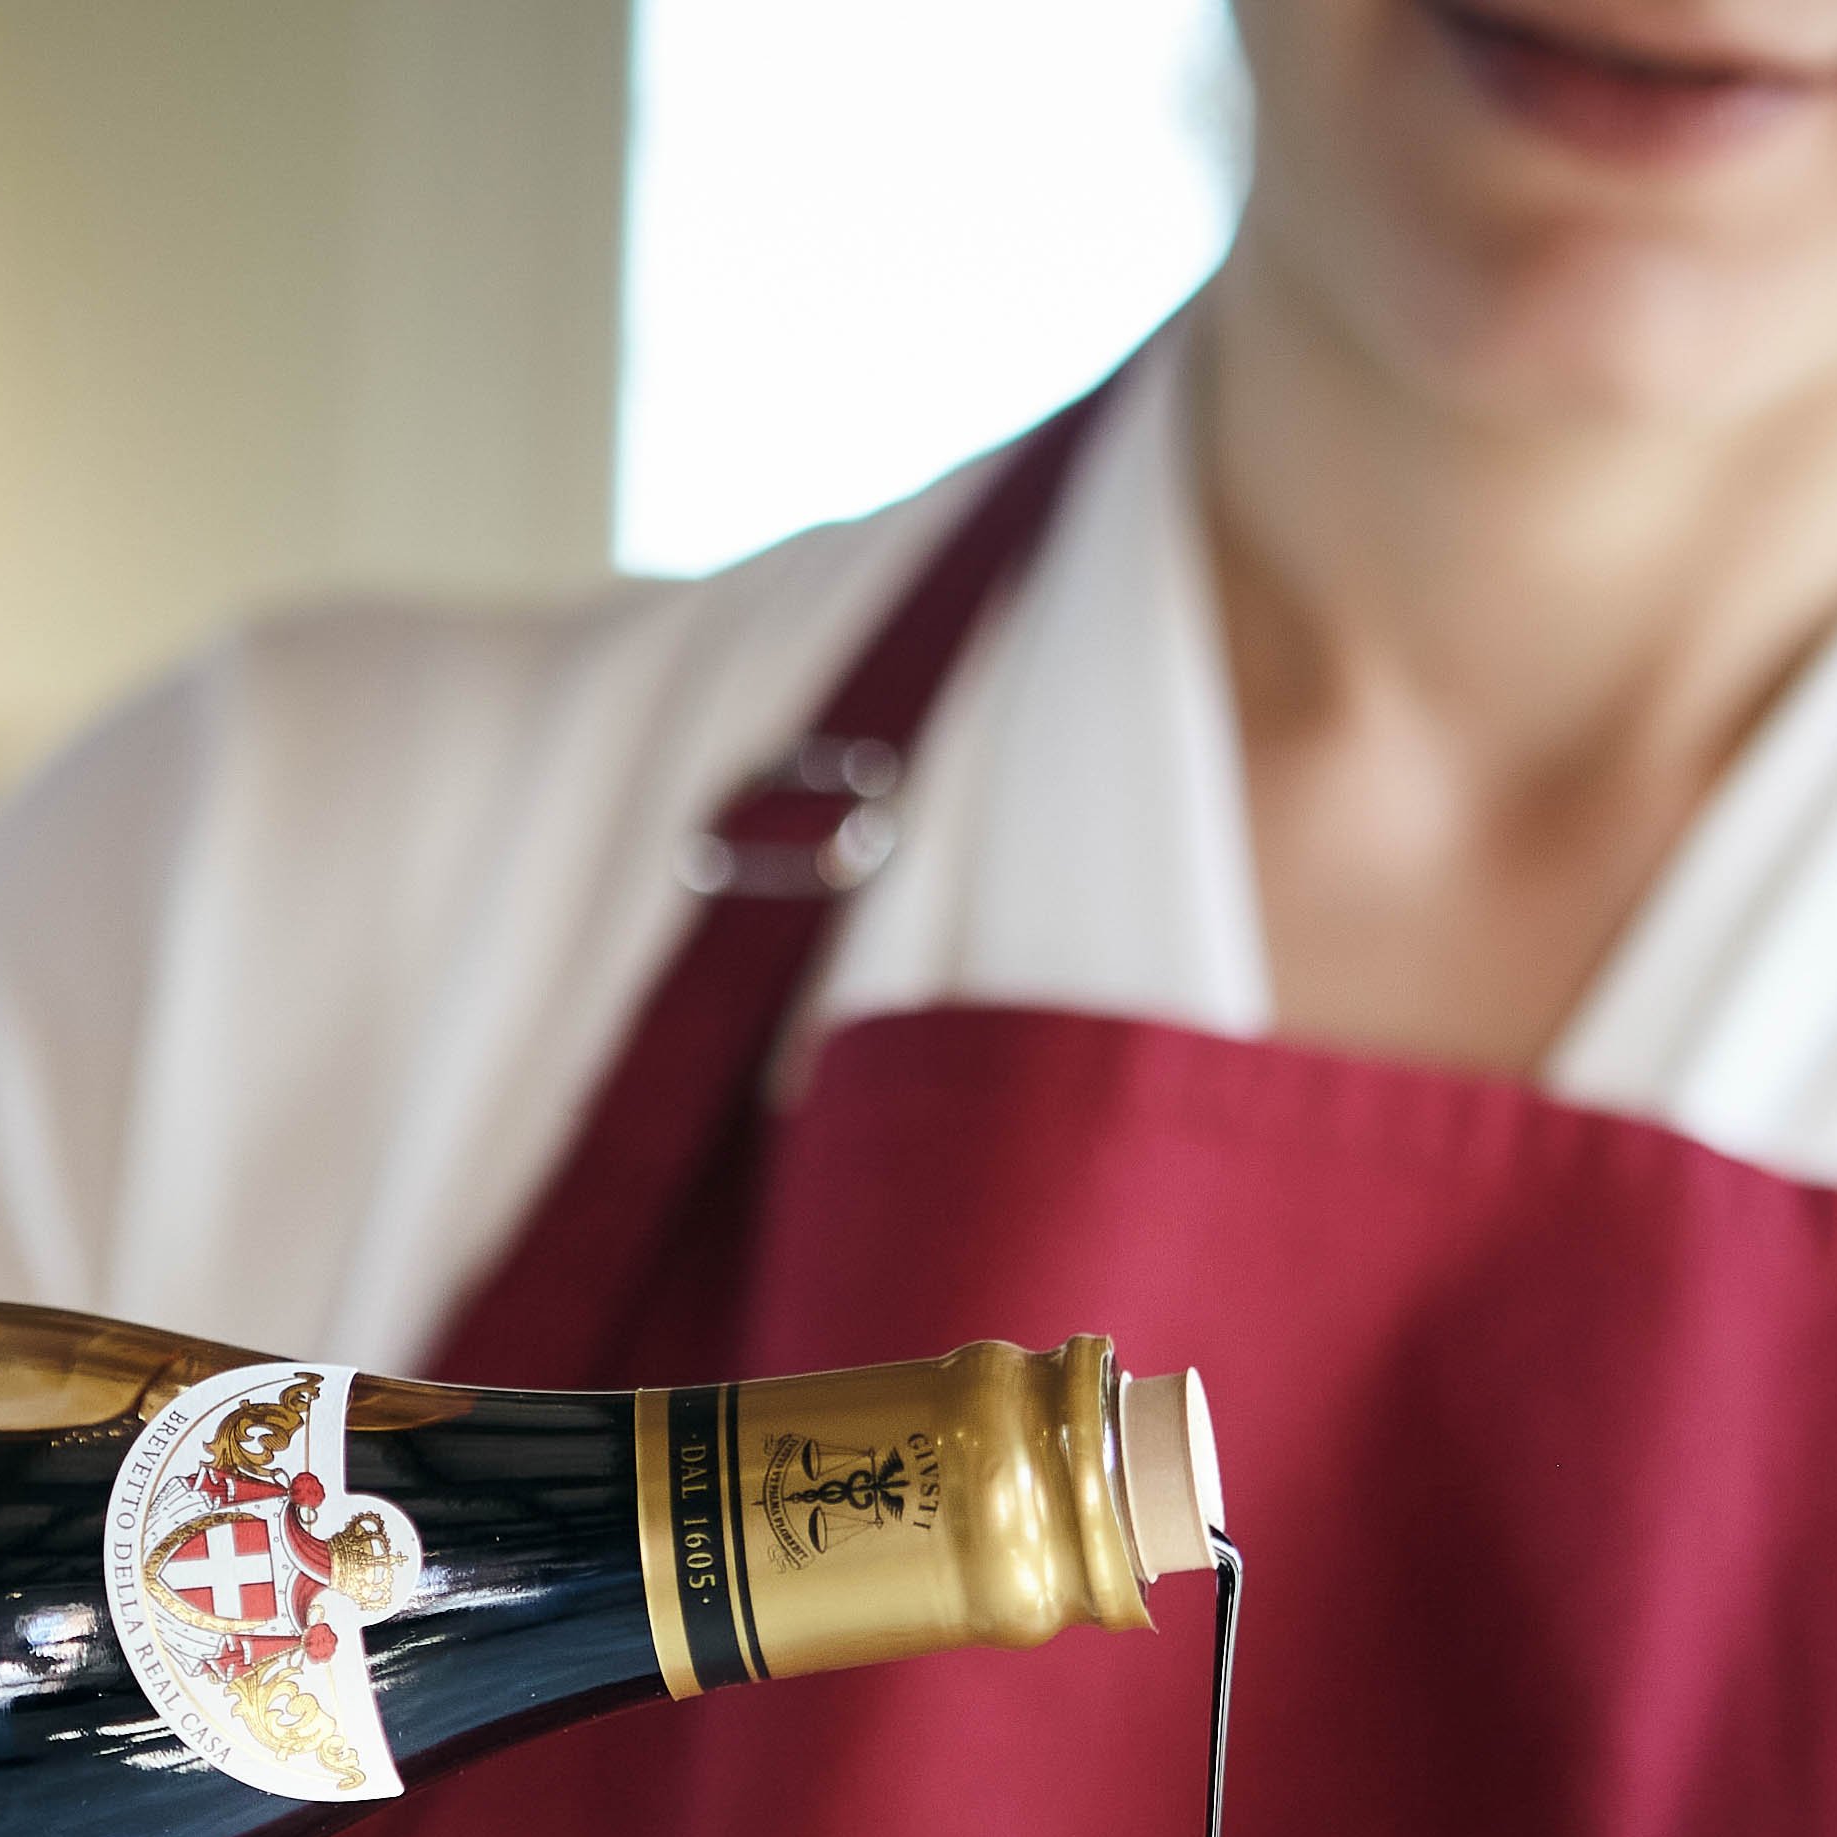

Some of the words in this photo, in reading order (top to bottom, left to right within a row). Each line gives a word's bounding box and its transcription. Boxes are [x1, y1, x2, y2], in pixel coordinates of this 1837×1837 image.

[116, 1410, 189, 1531] BREVETTO
[680, 1443, 708, 1500] DAL
[907, 1432, 942, 1531] GIVSTI
[114, 1541, 145, 1636] DELLA
[681, 1516, 716, 1592] 1605
[134, 1642, 182, 1712] REAL
[180, 1712, 234, 1764] CASA
